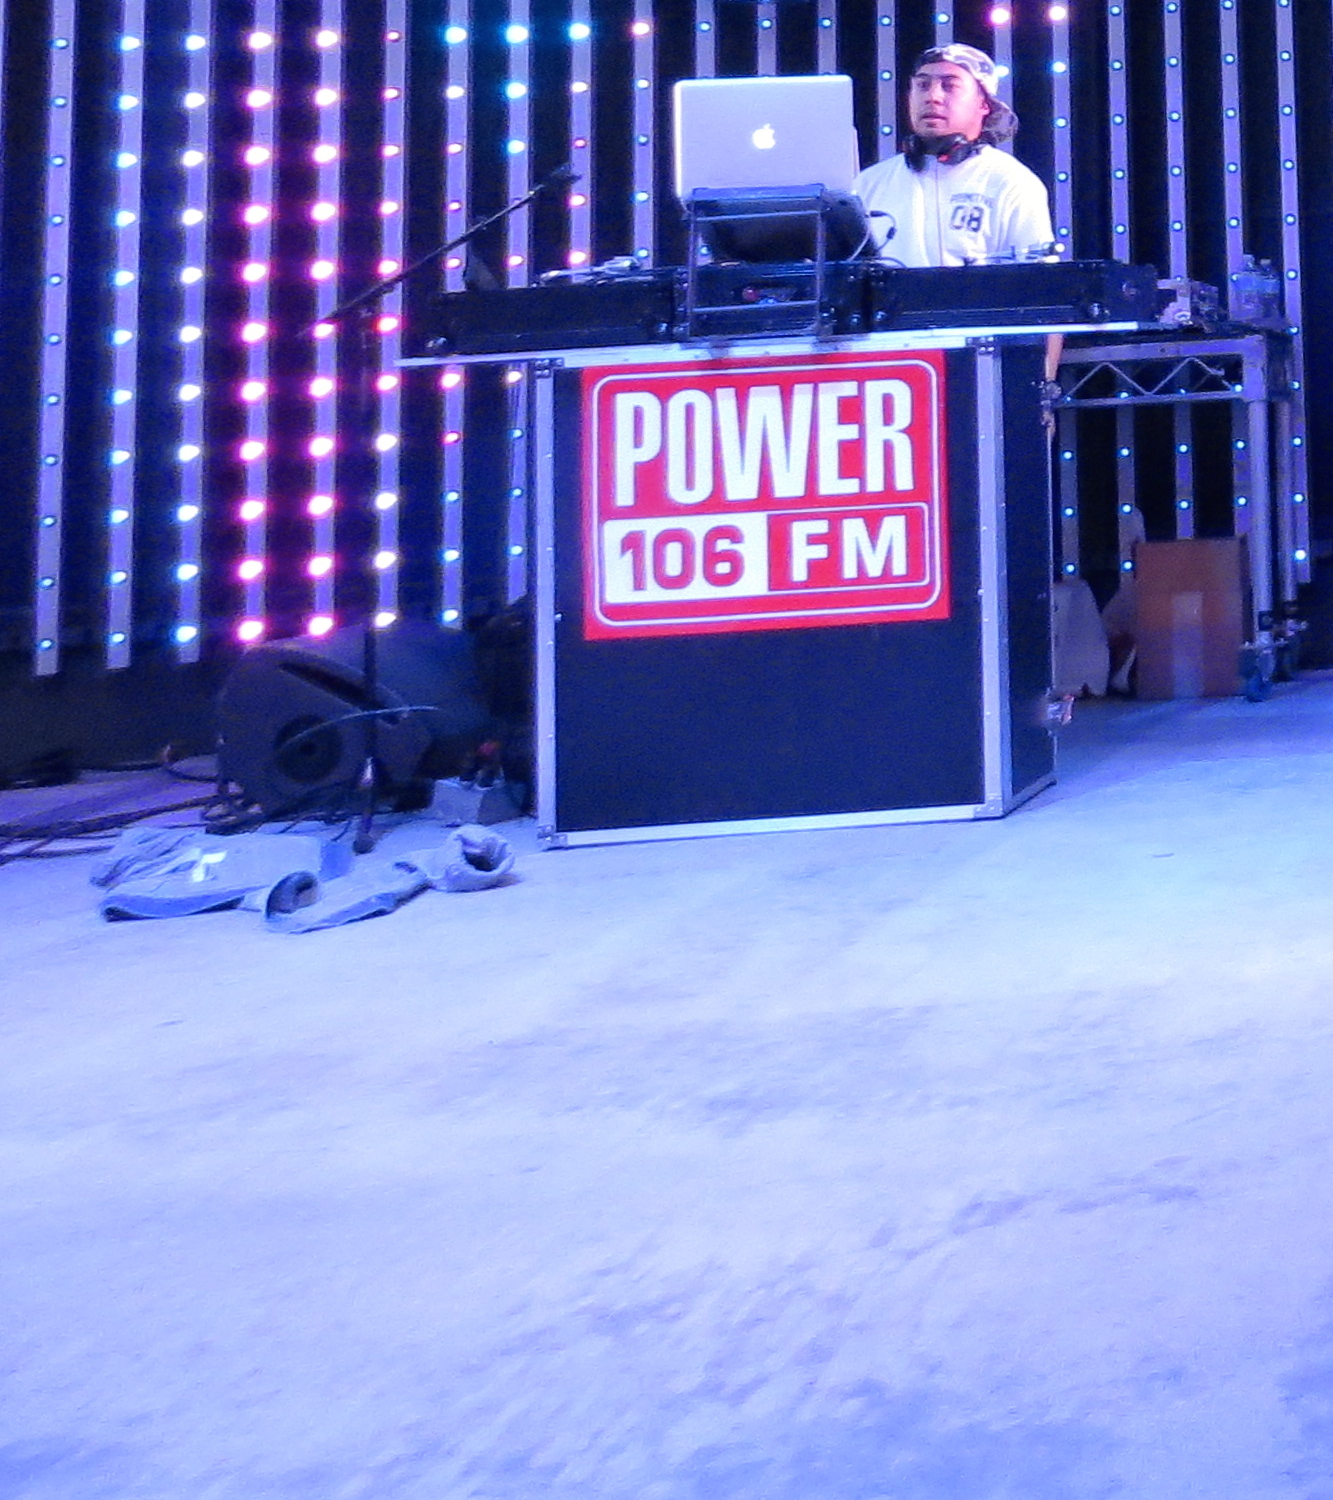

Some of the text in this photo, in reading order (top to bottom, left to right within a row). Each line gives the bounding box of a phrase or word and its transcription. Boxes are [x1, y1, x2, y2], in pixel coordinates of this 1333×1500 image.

[615, 380, 914, 507] POWER
[620, 515, 908, 592] 106 FM
